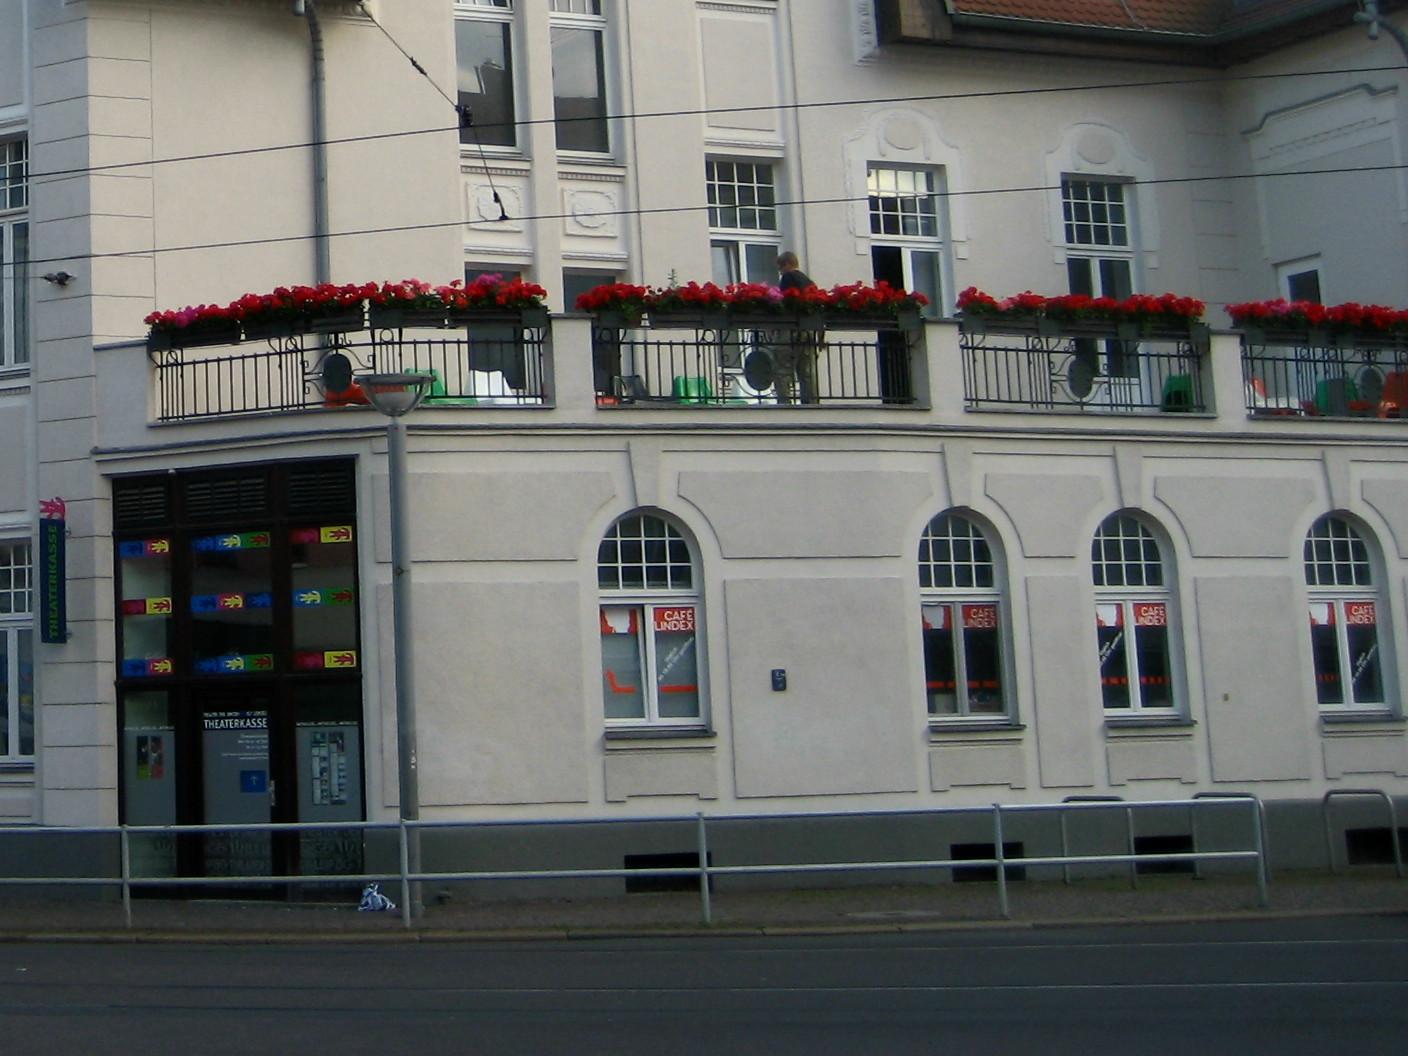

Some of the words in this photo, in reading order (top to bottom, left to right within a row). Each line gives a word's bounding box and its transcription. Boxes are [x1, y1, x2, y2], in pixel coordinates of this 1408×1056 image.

[48, 524, 59, 641] THEATERKASSE
[654, 621, 694, 631] LINDEX
[203, 718, 269, 729] THEATERKASSE
